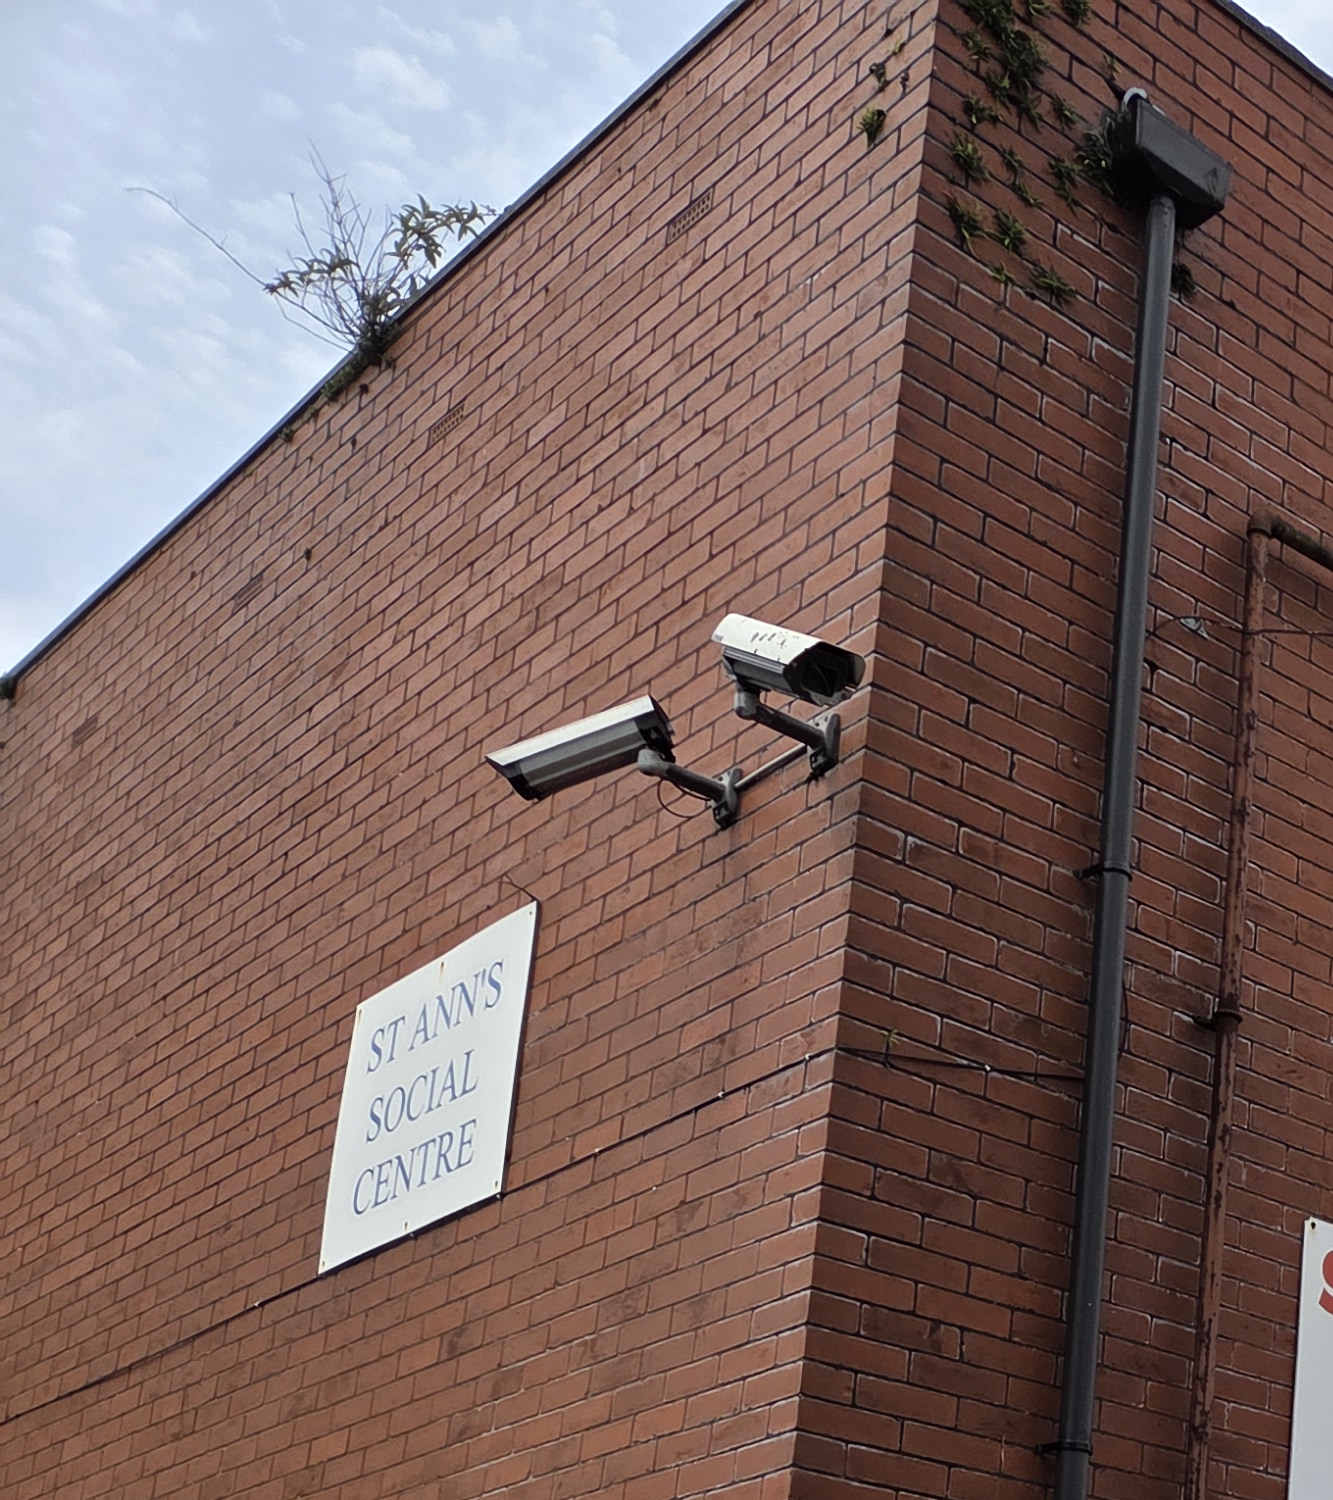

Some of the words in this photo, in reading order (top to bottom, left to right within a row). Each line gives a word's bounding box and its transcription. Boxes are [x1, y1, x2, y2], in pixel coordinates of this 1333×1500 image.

[367, 1015, 405, 1074] ST
[408, 958, 503, 1051] ANN'S
[366, 1049, 479, 1144] SOCIAL
[352, 1118, 477, 1216] CENTRE
